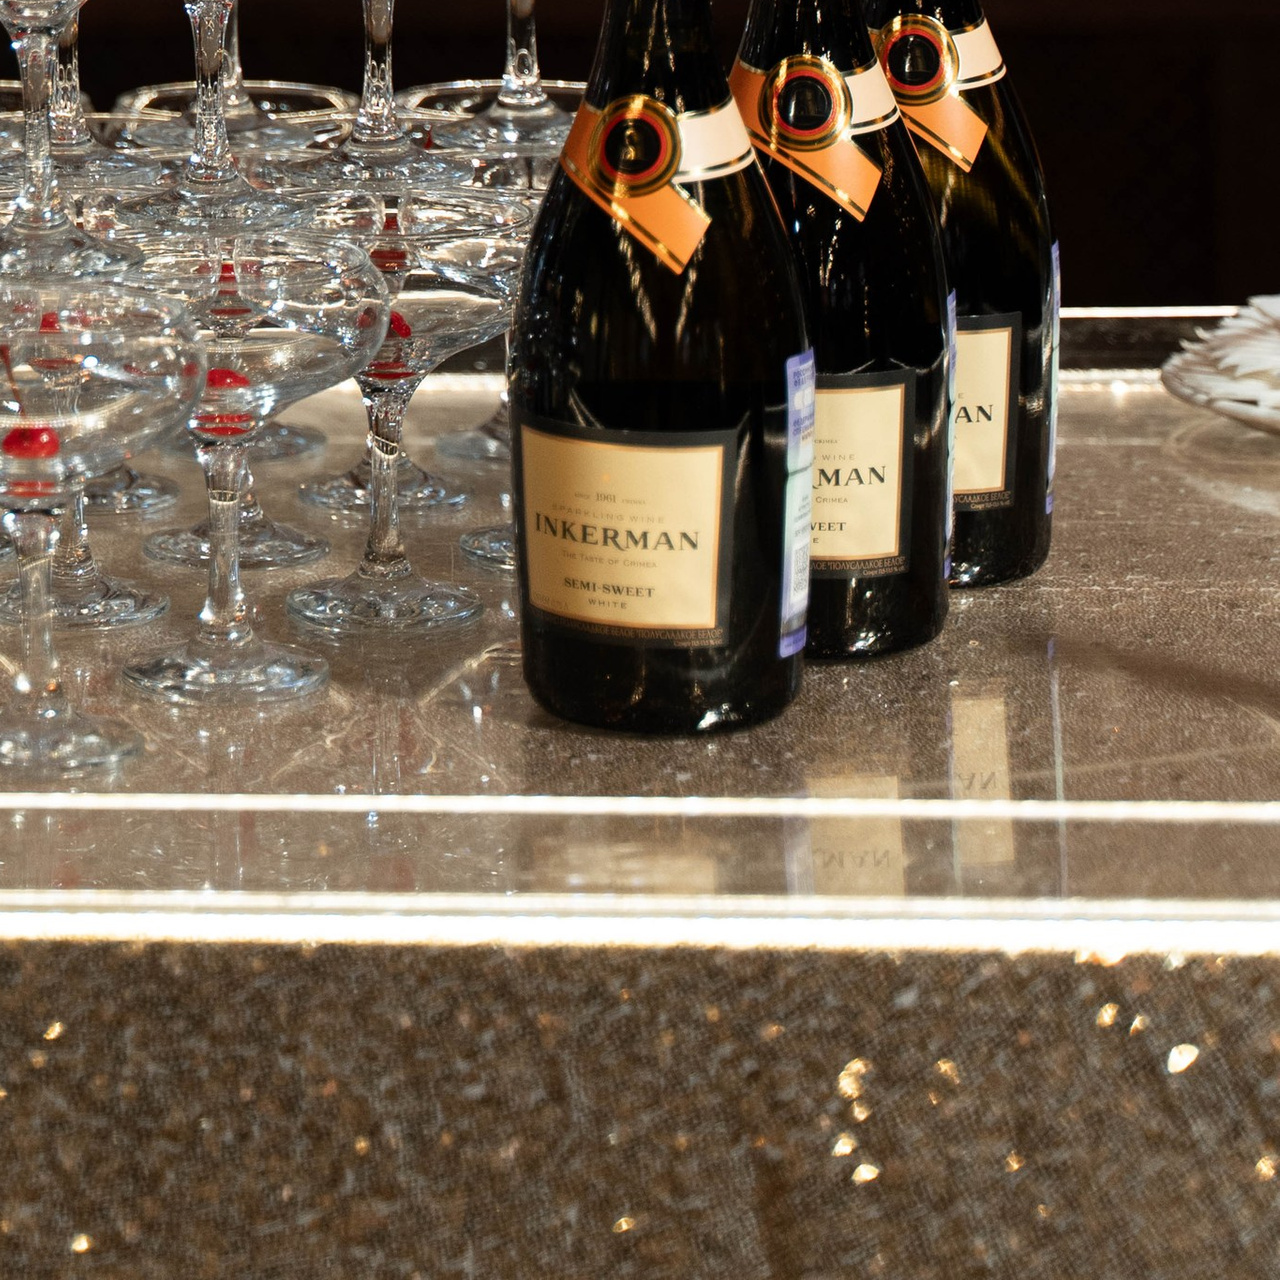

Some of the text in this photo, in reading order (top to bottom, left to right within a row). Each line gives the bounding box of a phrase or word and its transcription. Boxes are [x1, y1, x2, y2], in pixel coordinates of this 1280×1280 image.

[595, 492, 616, 504] 1961
[551, 503, 666, 525] SPARKLING WINE
[535, 512, 702, 552] INKERMAN
[564, 577, 655, 598] SEMI-SWEET
[587, 597, 628, 610] WHITE
